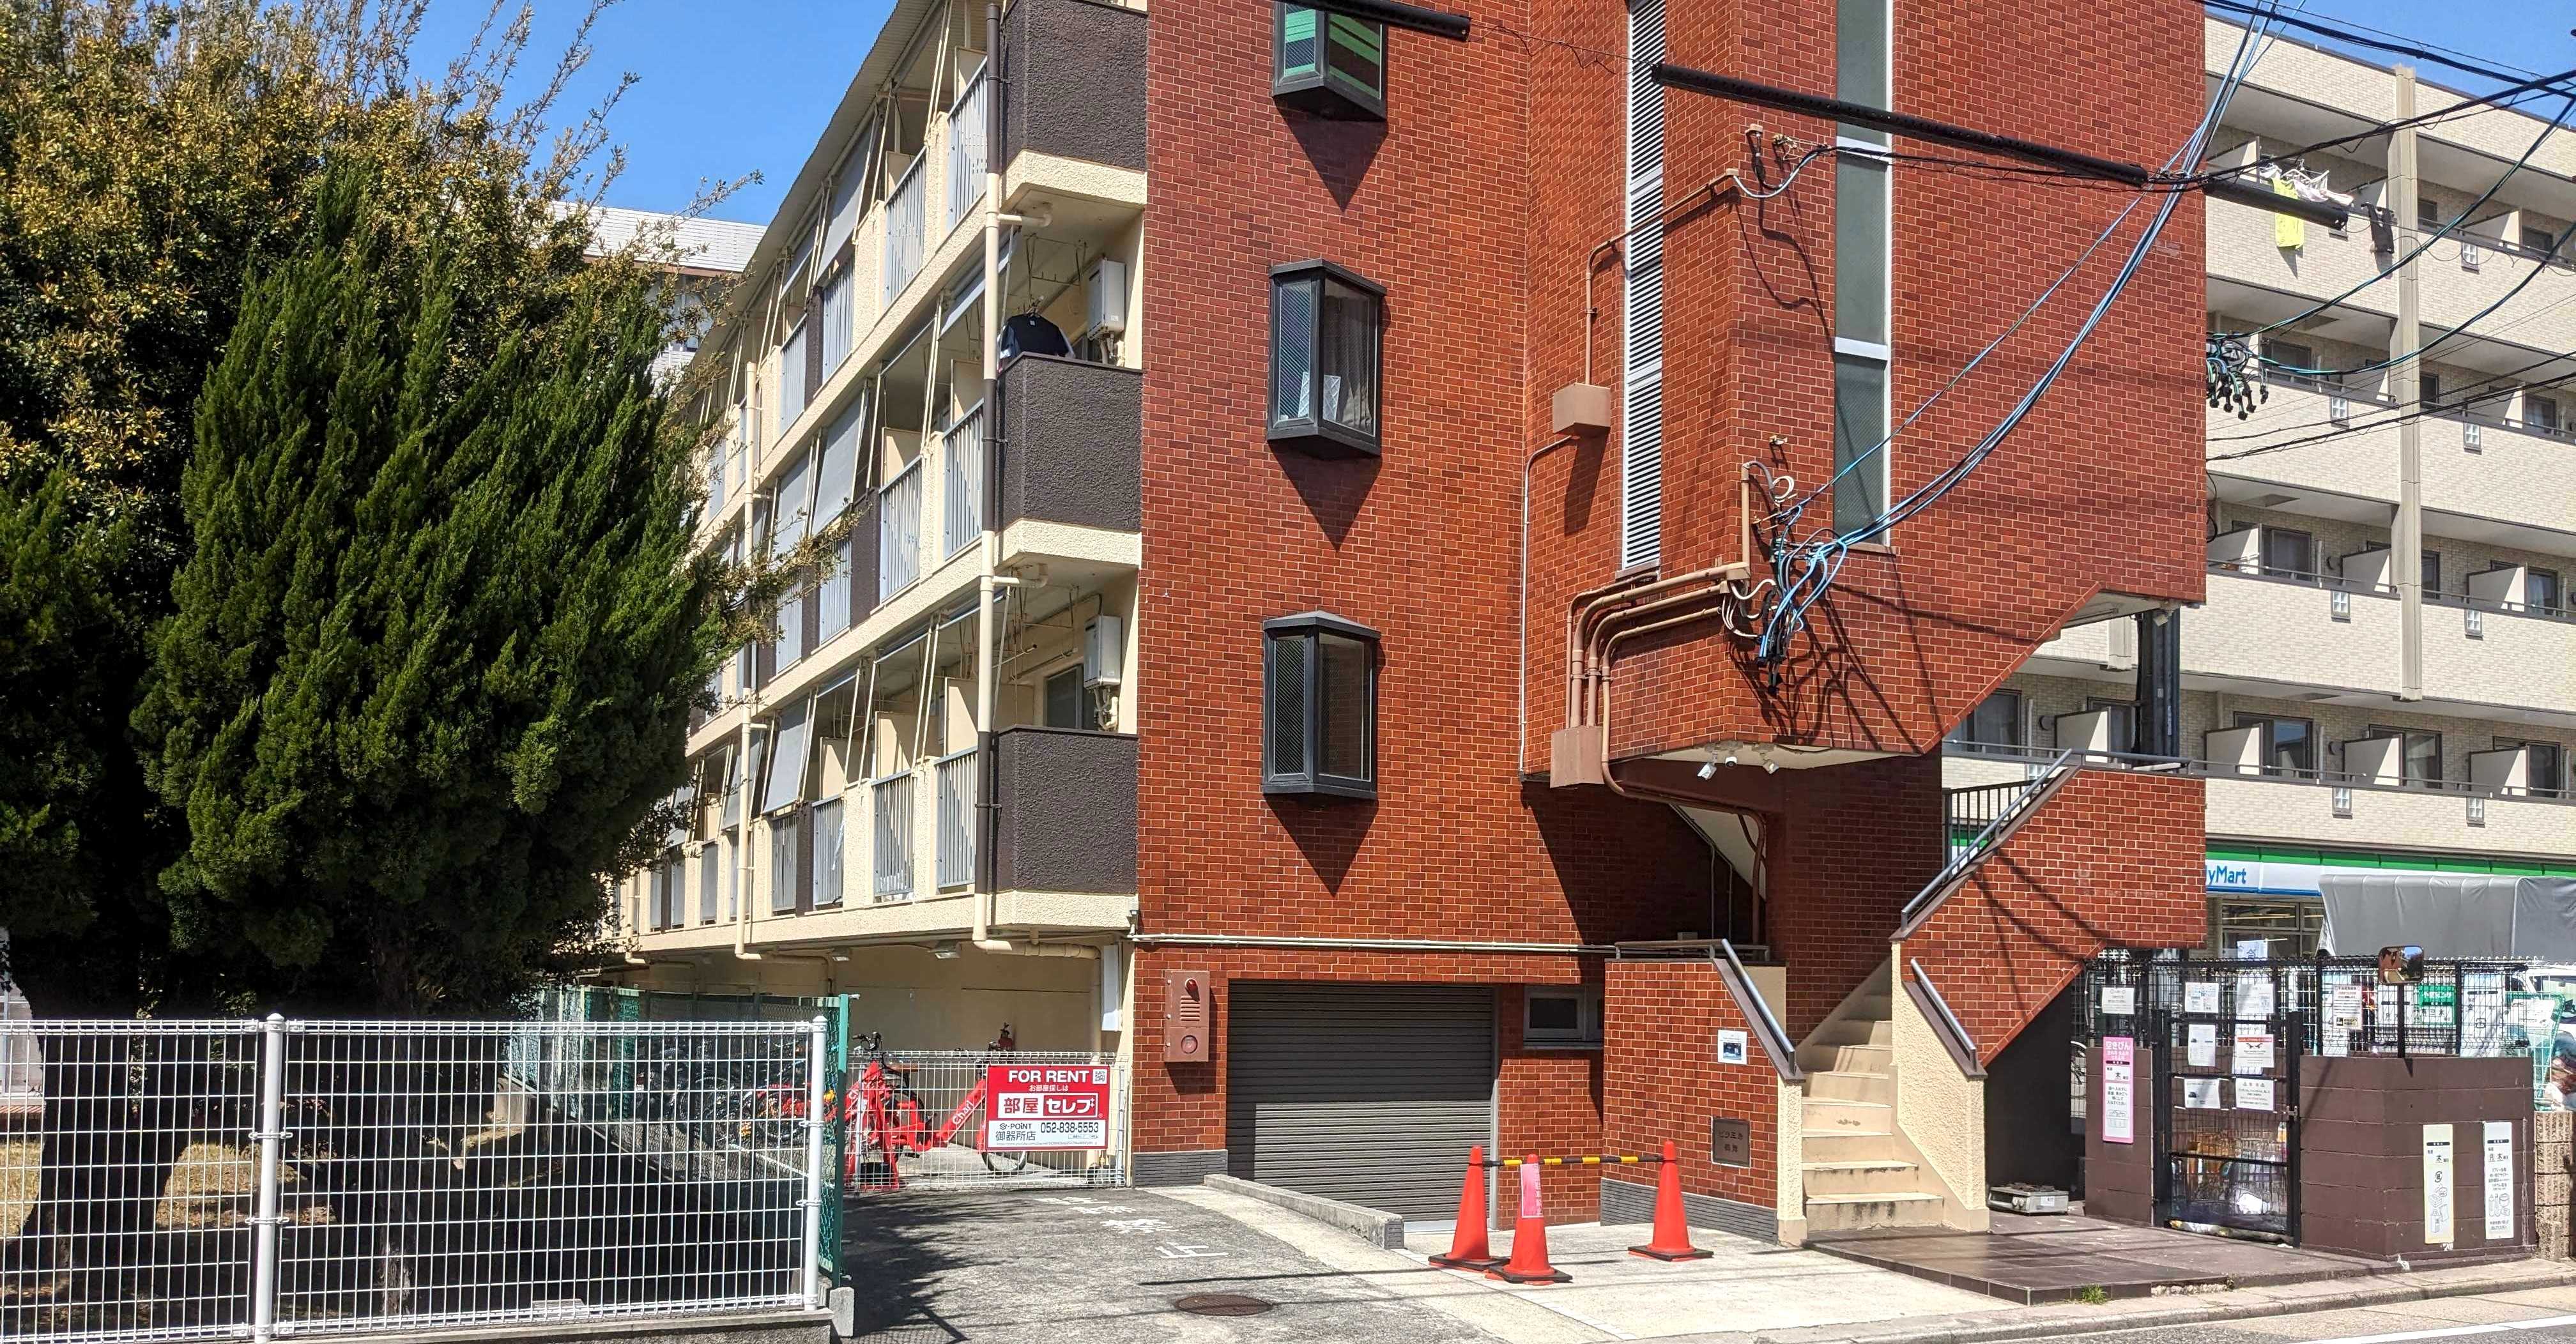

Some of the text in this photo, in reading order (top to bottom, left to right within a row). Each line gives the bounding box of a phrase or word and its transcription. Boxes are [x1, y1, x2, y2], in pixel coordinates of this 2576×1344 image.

[1008, 1070, 1089, 1083] FOR RENT
[1040, 1122, 1099, 1133] 052-838-5553
[995, 1131, 1036, 1142] 御器所店
